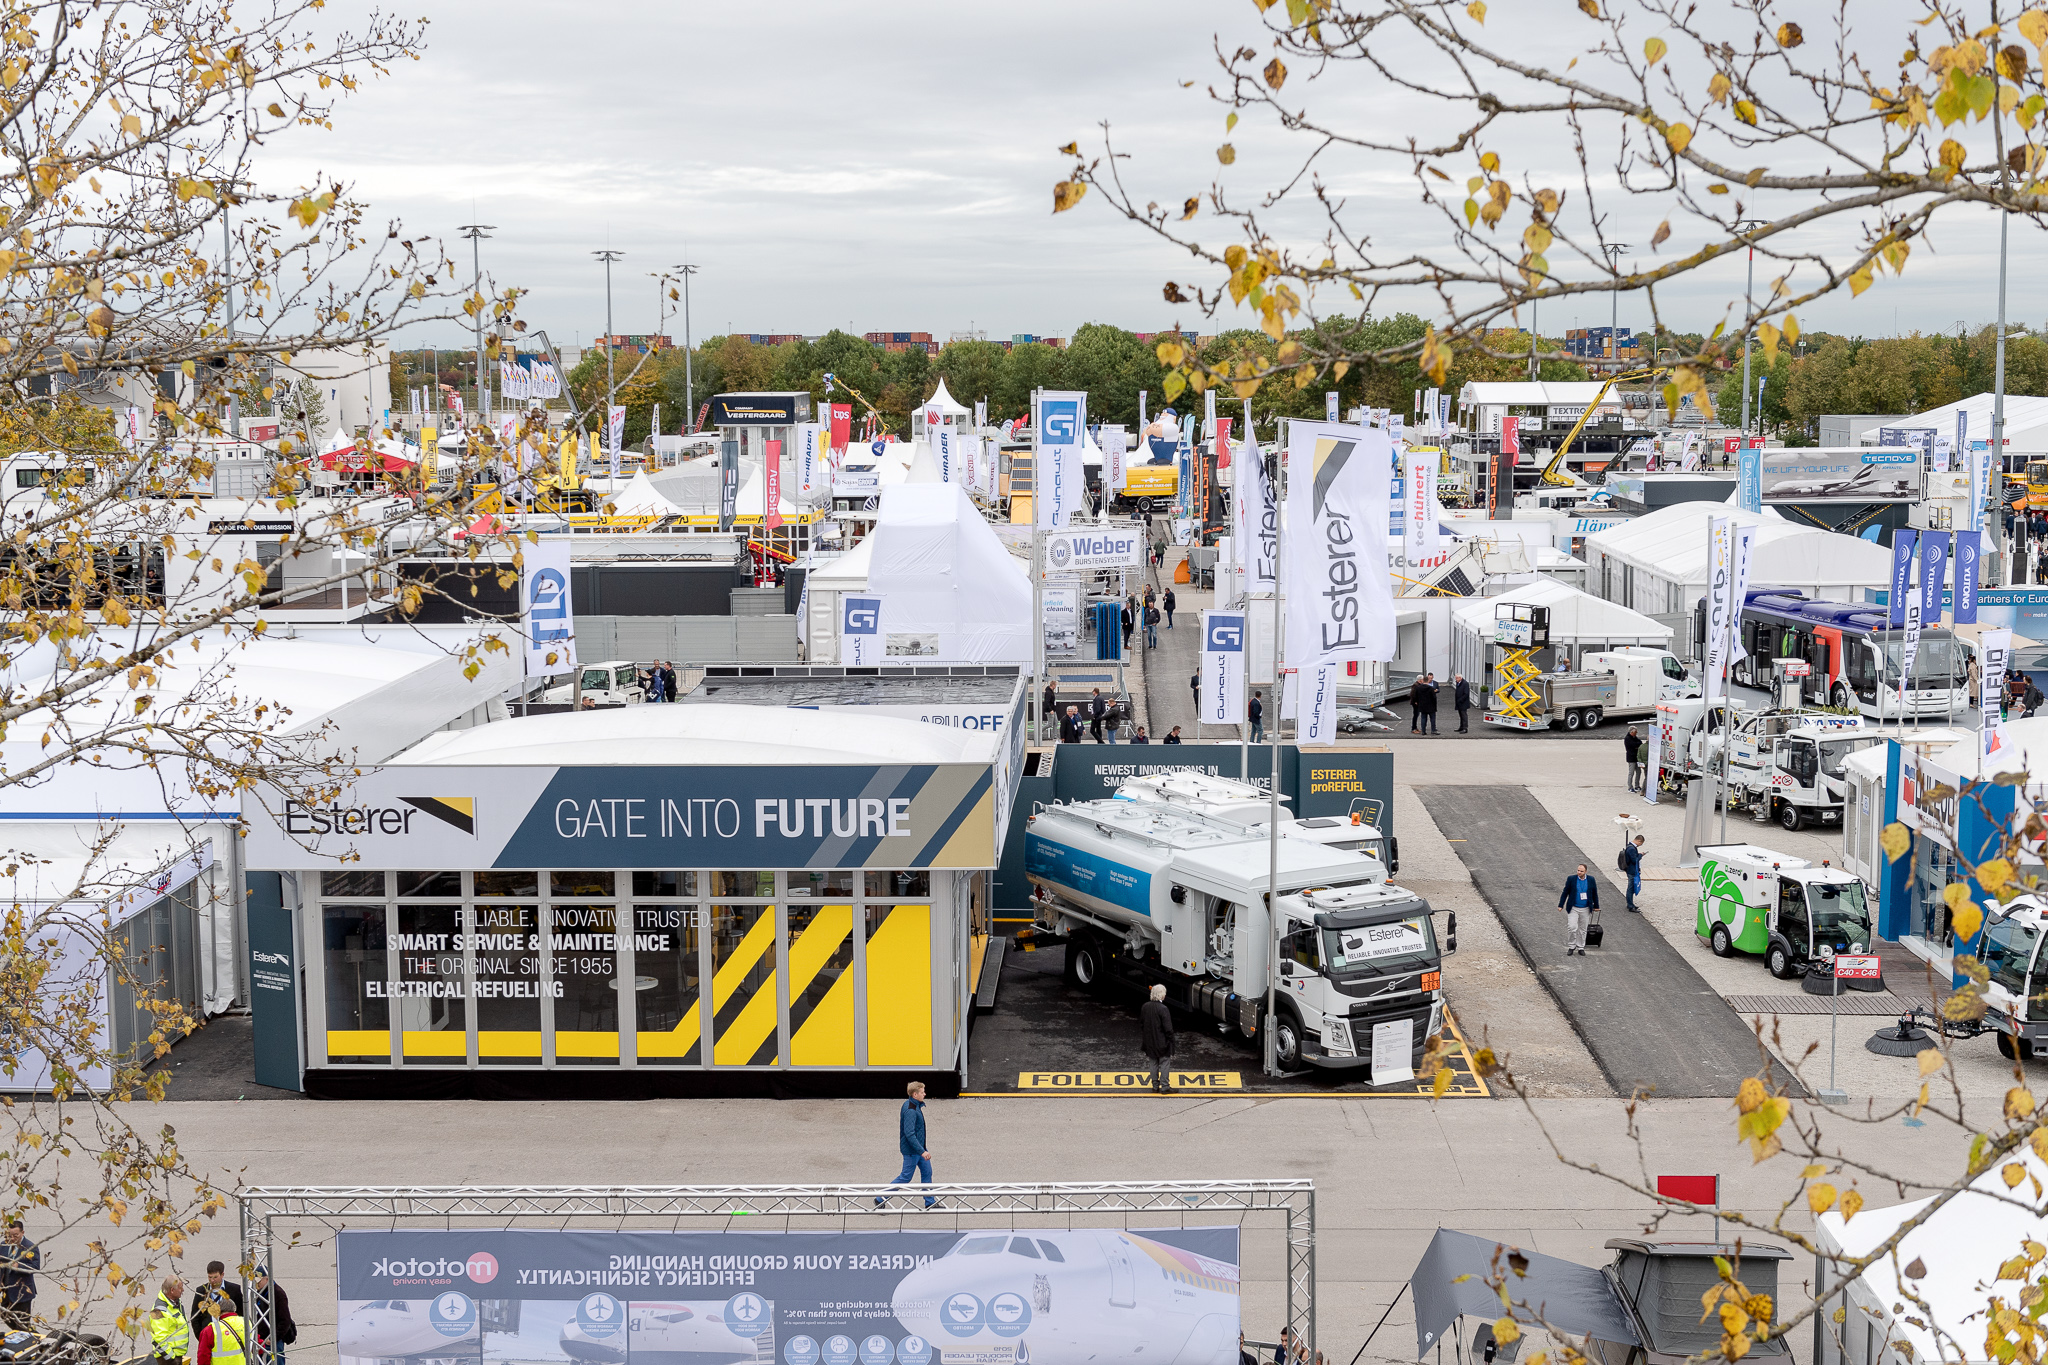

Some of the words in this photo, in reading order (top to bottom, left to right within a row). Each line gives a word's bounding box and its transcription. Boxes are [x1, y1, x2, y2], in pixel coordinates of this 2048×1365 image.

[833, 409, 850, 421] tips
[1553, 407, 1589, 415] TEXTRO
[804, 430, 812, 484] SCHRADER
[1864, 454, 1913, 463] TECNOVE
[1763, 466, 1778, 474] WE
[1780, 466, 1800, 474] LIFT
[1802, 465, 1826, 473] YOUR
[1827, 465, 1849, 473] LIFE
[1052, 448, 1062, 526] Guinault
[1490, 454, 1500, 520] HOLDER
[1415, 465, 1425, 547] techünert
[1073, 536, 1134, 556] Weber
[1075, 555, 1131, 566] BÜRSTENSYSTEME
[1322, 501, 1360, 651] Esterer
[1711, 525, 1725, 643] carboil
[1926, 565, 1937, 609] YUTONG
[1961, 566, 1971, 610] YUTONG
[1978, 594, 2011, 604] artners
[2013, 594, 2026, 604] for
[1046, 606, 1074, 614] cleaning
[1498, 620, 1528, 633] Electric
[1217, 654, 1226, 720] Guinault
[1985, 648, 2004, 729] DULEVO
[1309, 668, 1326, 739] Guinault
[962, 715, 1004, 731] OFF
[1660, 740, 1676, 749] arboil
[1731, 731, 1756, 745] carboil
[1094, 764, 1136, 775] NEWEST
[1207, 765, 1218, 776] IN
[1311, 769, 1357, 780] ESTERER
[1103, 776, 1128, 788] SMA
[1310, 782, 1366, 794] proREFUEL
[284, 799, 417, 835] Esterer
[554, 798, 645, 838] GATE
[660, 798, 741, 838] INTO
[755, 798, 911, 838] FUTURE
[1072, 863, 1082, 871] Proven
[1124, 880, 1133, 888] years
[454, 910, 533, 928] RELIABLE.
[540, 910, 635, 928] INNOVATIVE.
[637, 910, 714, 929] TRUSTED.
[1369, 926, 1405, 942] Esterer
[388, 933, 448, 951] SMART
[452, 933, 524, 951] SERVICE
[528, 933, 542, 951] &
[551, 933, 670, 952] MAINTENANCE
[253, 950, 278, 964] Esterer
[1347, 950, 1371, 960] RELIABLE.
[1372, 947, 1401, 956] INNOVATIVE.
[1402, 943, 1424, 953] TRUSTED.
[404, 957, 437, 974] THE
[441, 957, 514, 975] ORIGINAL
[520, 957, 568, 975] SINCE
[571, 957, 612, 975] 1955
[1838, 968, 1855, 977] C40
[1861, 968, 1878, 977] C46
[366, 980, 466, 998] ELECTRICAL
[471, 980, 564, 999] REFUELING
[1032, 1074, 1152, 1086] FOLLOW
[1178, 1074, 1228, 1086] ME
